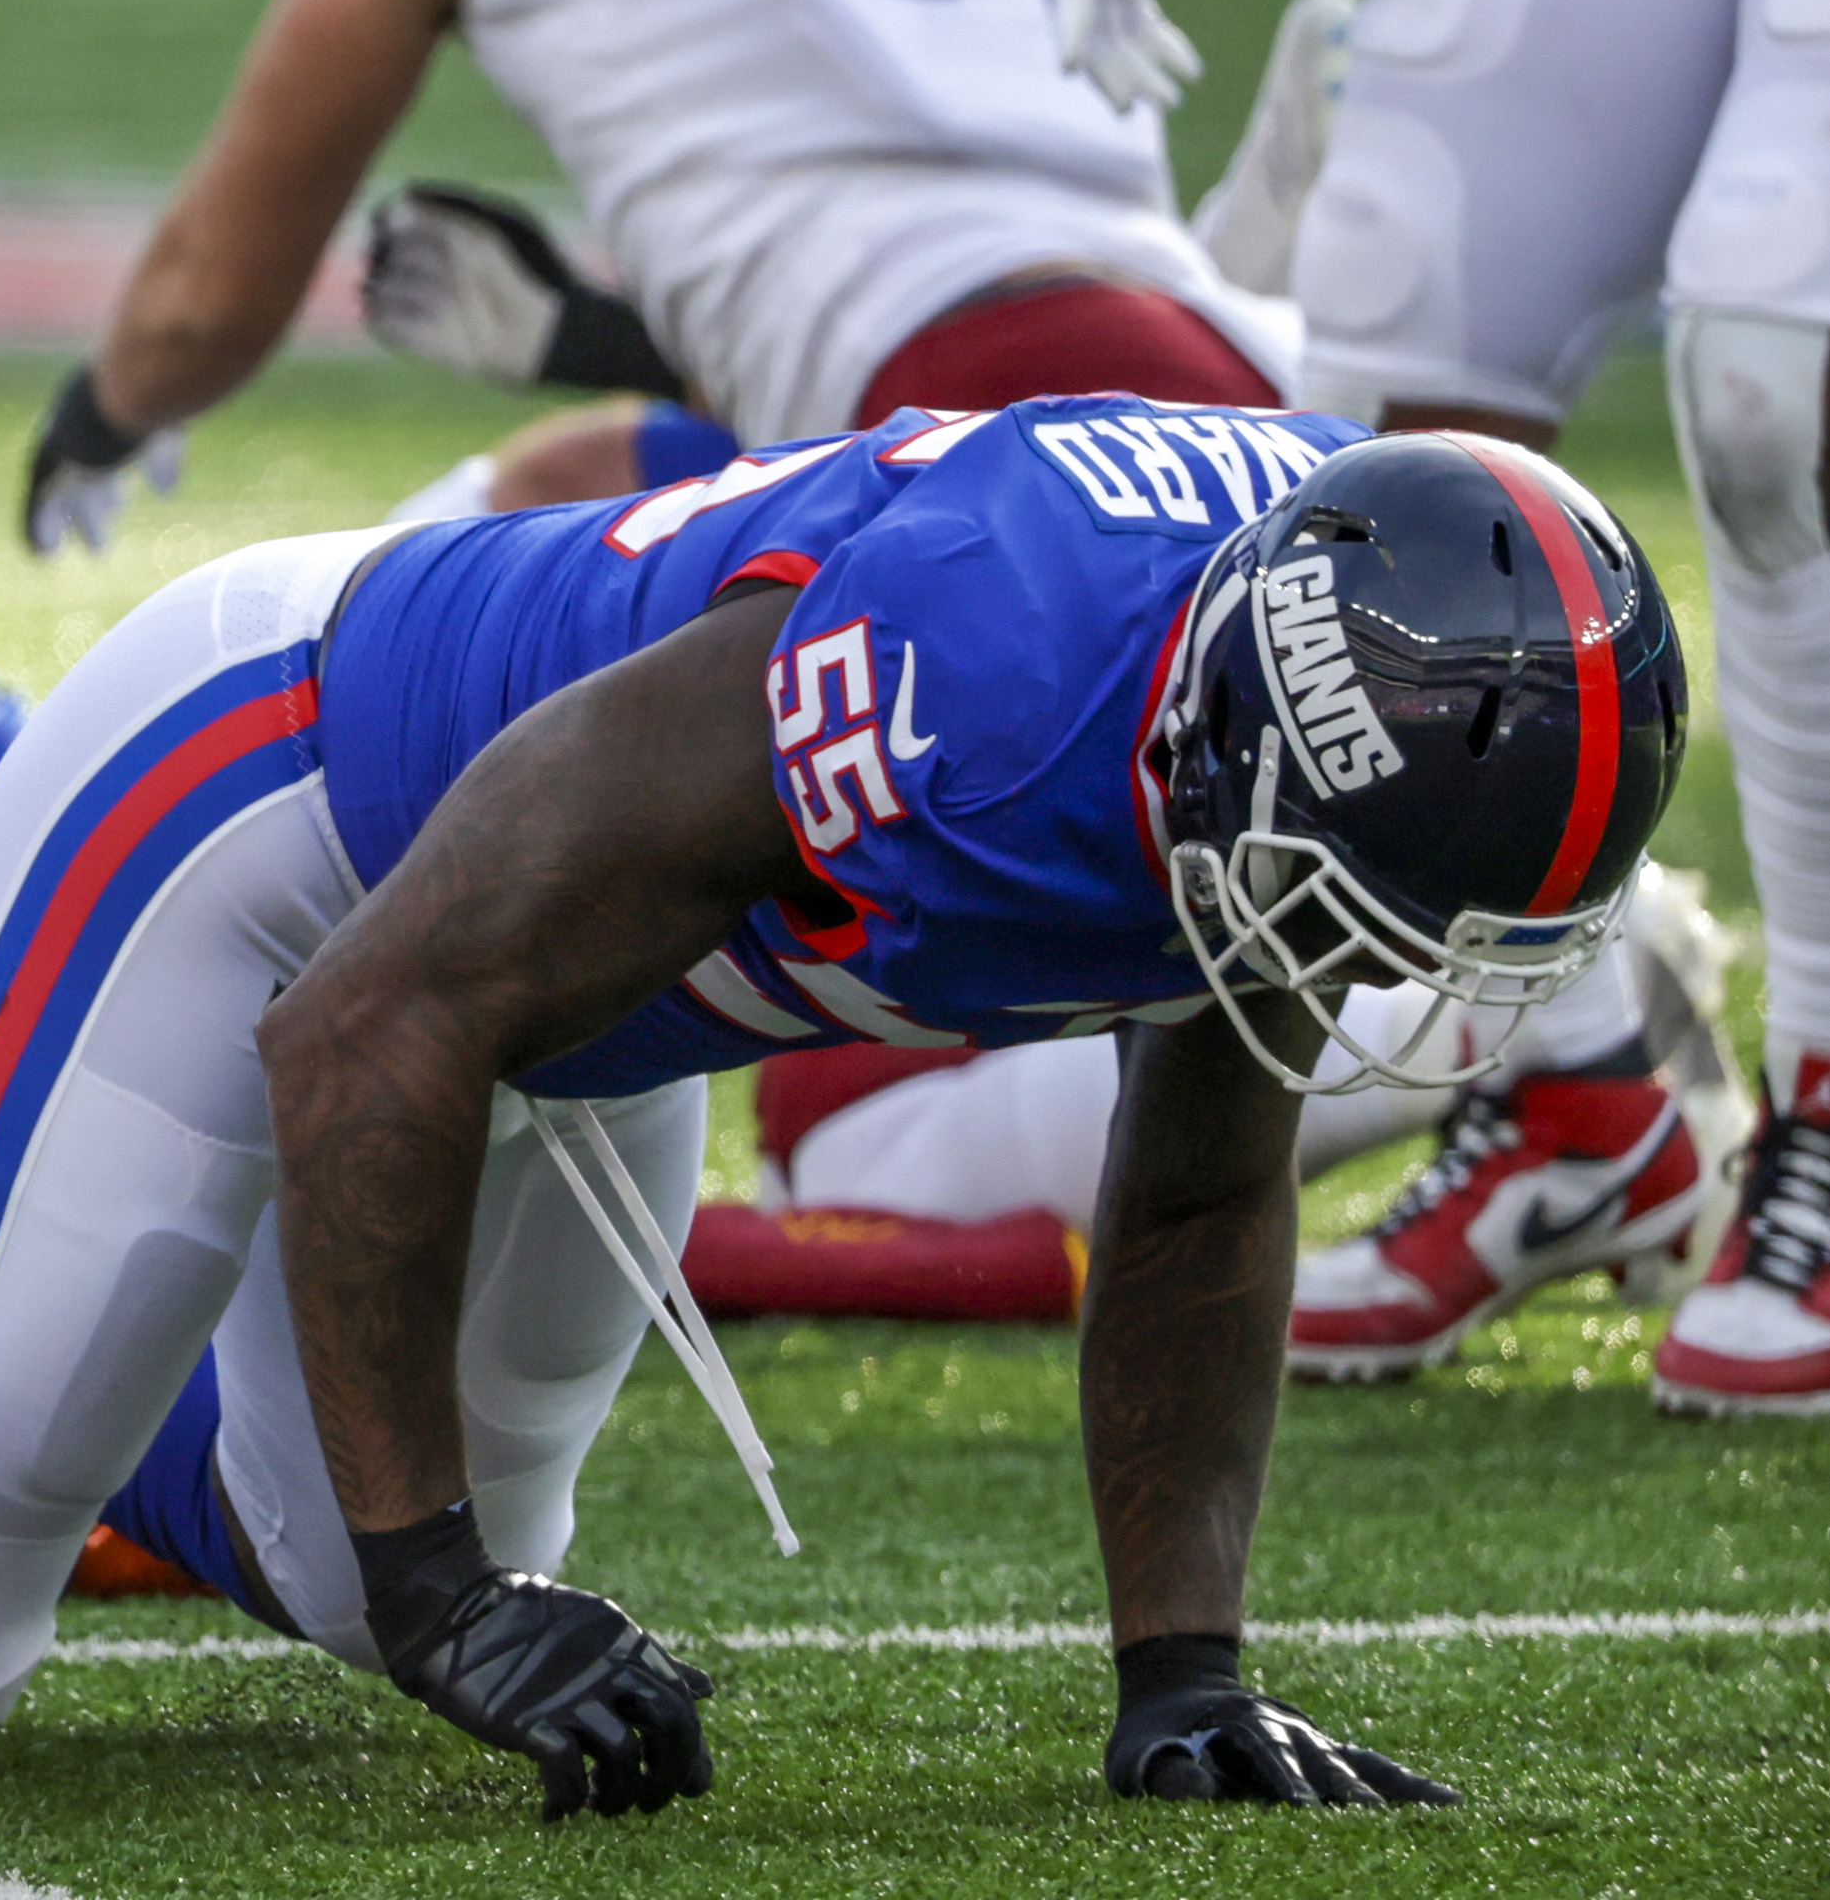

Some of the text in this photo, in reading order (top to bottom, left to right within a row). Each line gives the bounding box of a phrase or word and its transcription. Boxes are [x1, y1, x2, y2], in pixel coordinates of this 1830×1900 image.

[1032, 414, 1329, 526] WARD
[765, 614, 907, 857] 55
[1263, 552, 1406, 793] GIANTS
